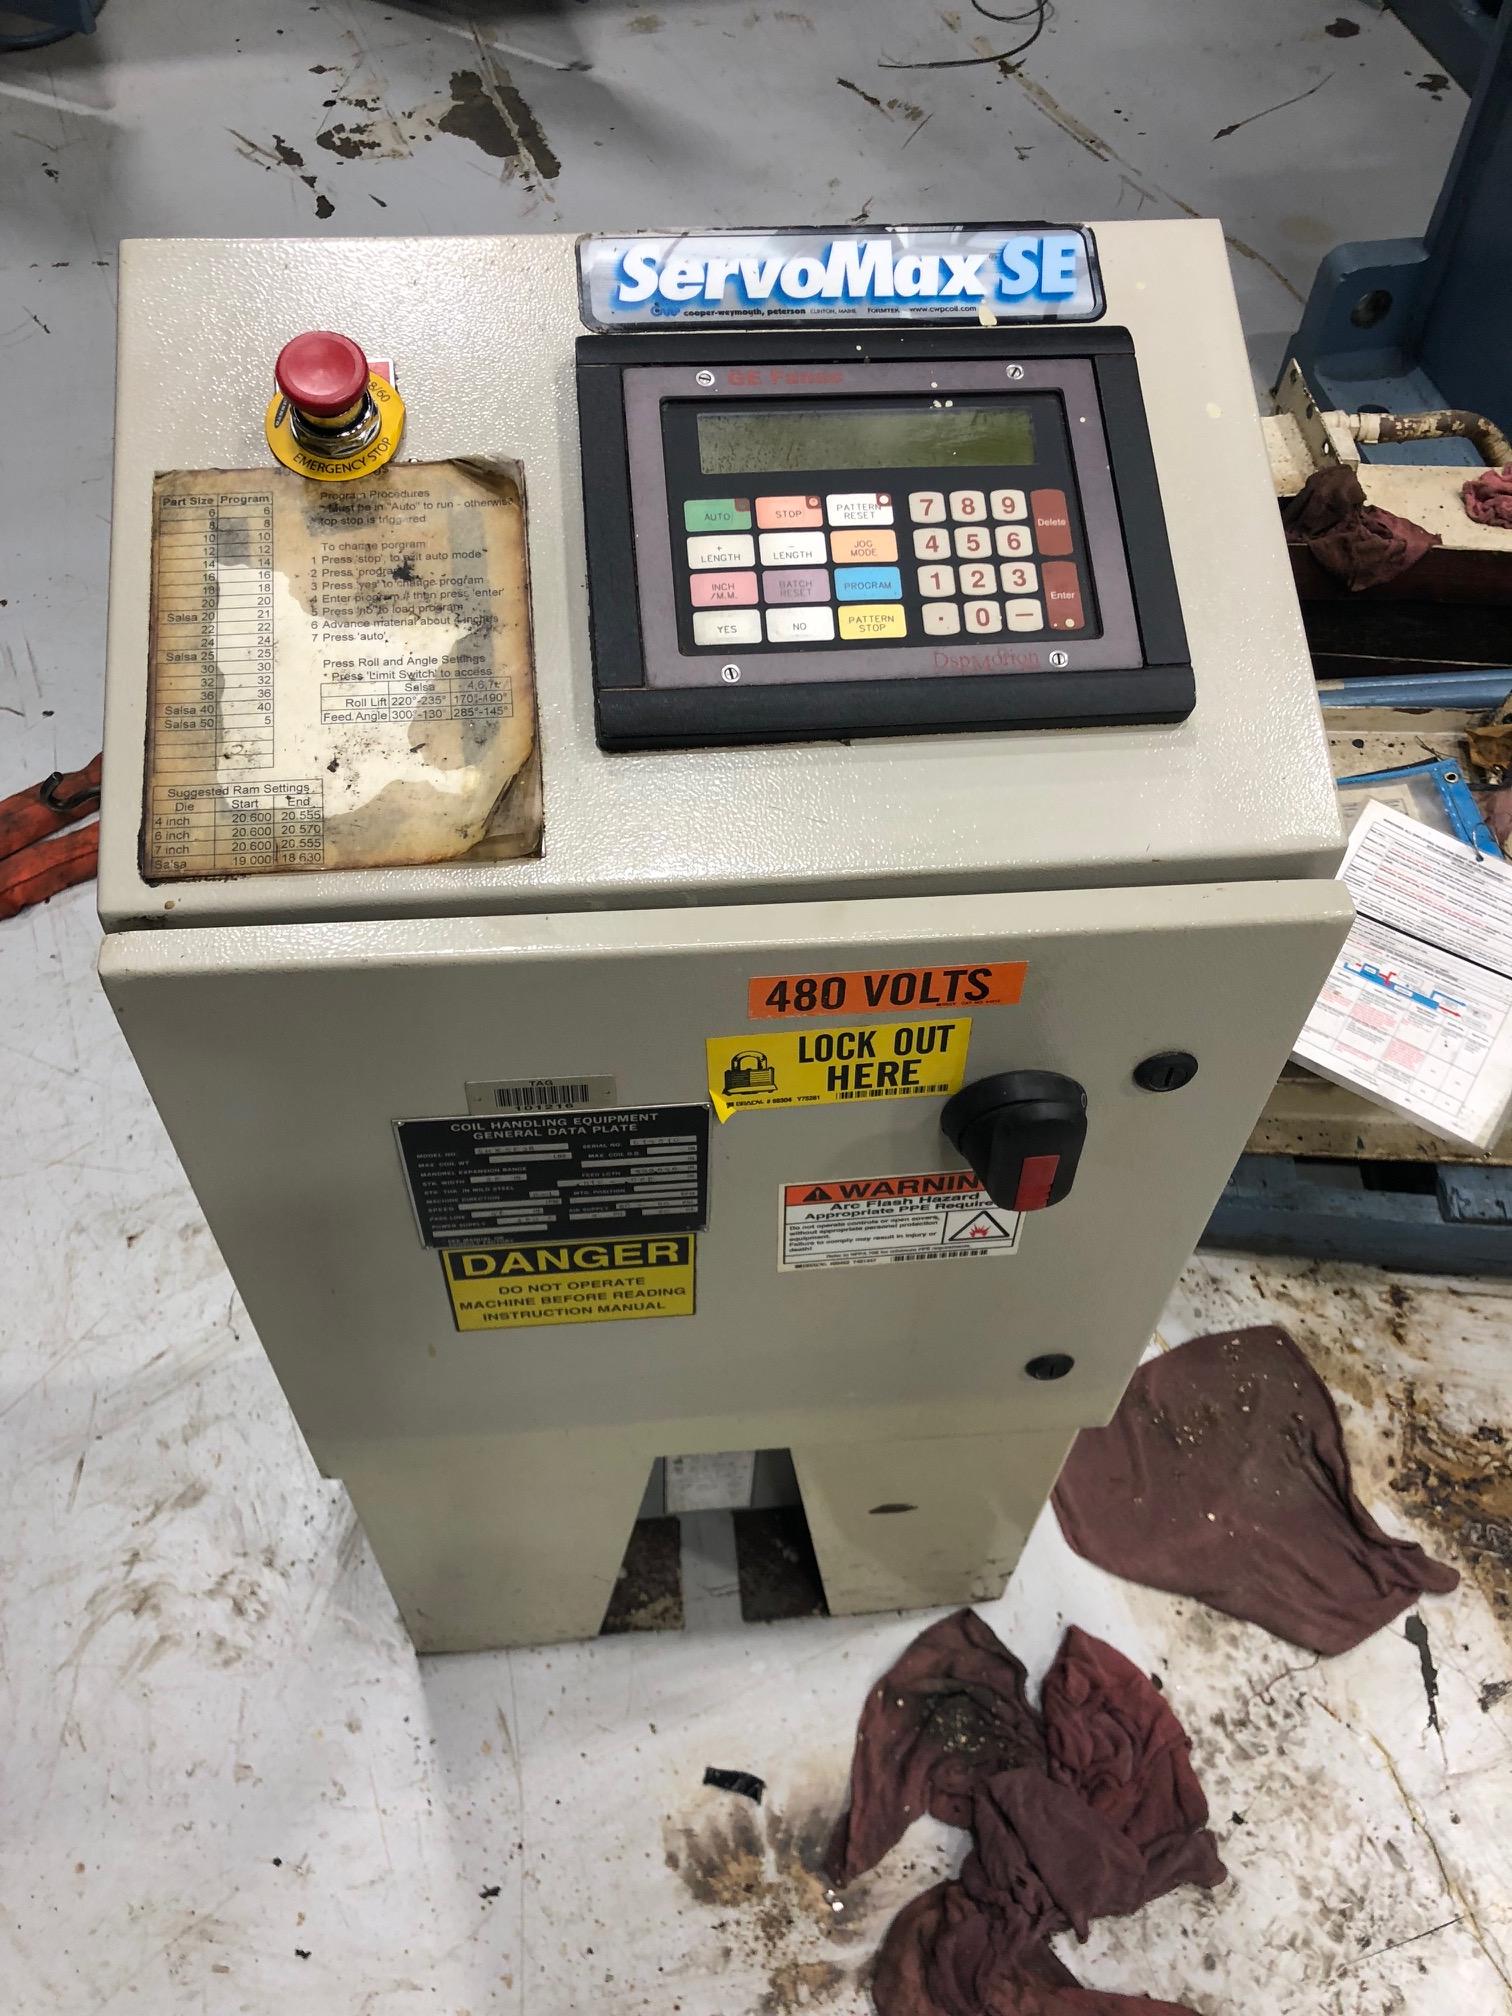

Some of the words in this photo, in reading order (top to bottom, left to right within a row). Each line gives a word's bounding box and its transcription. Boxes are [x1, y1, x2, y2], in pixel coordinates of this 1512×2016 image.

[1001, 235, 1077, 296] SE
[684, 309, 763, 318] cooper-weymouth,
[767, 308, 806, 316] peterson
[728, 371, 760, 385] GE
[769, 371, 844, 385] Fanuc
[293, 453, 366, 473] EMERGENCY
[368, 437, 391, 461] STOP
[163, 498, 186, 506] Part
[190, 497, 214, 505] Size
[220, 495, 269, 505] Program
[1002, 497, 1015, 513] 9
[424, 502, 433, 510] to
[920, 499, 933, 516] 7
[962, 498, 975, 515] 8
[704, 513, 731, 521] AUTO
[776, 510, 802, 518] STOP
[341, 516, 363, 526] stop
[322, 542, 335, 551] To
[855, 540, 873, 548] JOG
[926, 535, 939, 552] 4
[967, 534, 980, 551] 5
[1007, 533, 1021, 550] 6
[322, 556, 352, 564] Press
[390, 554, 399, 562] to
[425, 552, 448, 560] auto
[452, 550, 482, 559] mode
[774, 551, 813, 559] LENGTH
[851, 548, 877, 556] MODE
[701, 554, 741, 563] LENGTH
[322, 568, 353, 577] Press
[1012, 569, 1026, 586] 3
[311, 582, 317, 590] 3
[322, 582, 353, 590] Press
[440, 578, 484, 587] program
[931, 572, 940, 590] 1
[971, 571, 985, 588] 2
[712, 583, 735, 591] INCH
[844, 582, 891, 590] PROGRAM
[322, 595, 351, 603] Enter
[440, 590, 470, 600] press
[323, 607, 353, 616] Press
[393, 605, 415, 613] load
[167, 613, 198, 622] Salsa
[202, 612, 215, 621] 20
[849, 615, 894, 624] PATTERN
[976, 608, 990, 626] 0
[311, 621, 318, 629] 6
[322, 620, 370, 629] Advance
[420, 617, 450, 625] about
[859, 624, 886, 632] STOP
[312, 634, 318, 642] 7
[323, 633, 354, 642] Press
[166, 653, 197, 661] Salsa
[201, 651, 214, 660] 25
[323, 659, 354, 668] Press
[359, 658, 379, 667] Roll
[383, 658, 403, 666] and
[407, 656, 438, 667] Angle
[332, 672, 364, 680] Press
[441, 669, 450, 677] to
[455, 668, 492, 676] access
[405, 683, 435, 691] Salsa
[346, 698, 368, 708] Roll
[371, 697, 387, 707] Lift
[165, 706, 196, 715] Salsa
[200, 705, 214, 713] 40
[323, 712, 353, 722] Feed
[356, 711, 387, 722] Angle
[165, 720, 196, 728] Salsa
[200, 718, 214, 727] 50
[168, 788, 229, 799] Suggested
[233, 785, 260, 795] Ram
[264, 784, 310, 793] Settings
[175, 802, 194, 812] Die
[232, 800, 258, 809] Start
[288, 798, 310, 806] End
[155, 818, 162, 826] 4
[166, 817, 190, 825] inch
[155, 832, 162, 840] 6
[166, 830, 189, 839] inch
[155, 846, 162, 854] 7
[166, 845, 189, 853] inch
[765, 977, 847, 1013] 480
[864, 968, 992, 1007] VOLTS
[799, 1031, 877, 1064] LOCK
[893, 1025, 955, 1055] OUT
[827, 1059, 921, 1092] HERE
[515, 1103, 574, 1112] 101216
[451, 1123, 485, 1132] COIL
[491, 1118, 568, 1130] HANDLING
[574, 1113, 658, 1126] EQUIPMENT
[473, 1129, 542, 1140] GENERAL
[548, 1126, 586, 1136] DATA
[592, 1124, 638, 1133] PLATE
[839, 1175, 982, 1199] WARNIN
[866, 1198, 913, 1208] Flash
[920, 1193, 979, 1203] Hazard
[805, 1208, 894, 1220] Appropriate
[899, 1204, 930, 1212] PPE
[935, 1201, 994, 1210] Require
[462, 1241, 679, 1277] DANGER
[499, 1286, 523, 1295] DO
[528, 1283, 561, 1294] NOT
[567, 1277, 646, 1290] OPERATE
[460, 1299, 537, 1311] MACHINE
[541, 1292, 607, 1305] BEFORE
[613, 1287, 686, 1300] READING
[483, 1307, 593, 1322] INSTRUCTION
[597, 1301, 666, 1313] MANUAL
